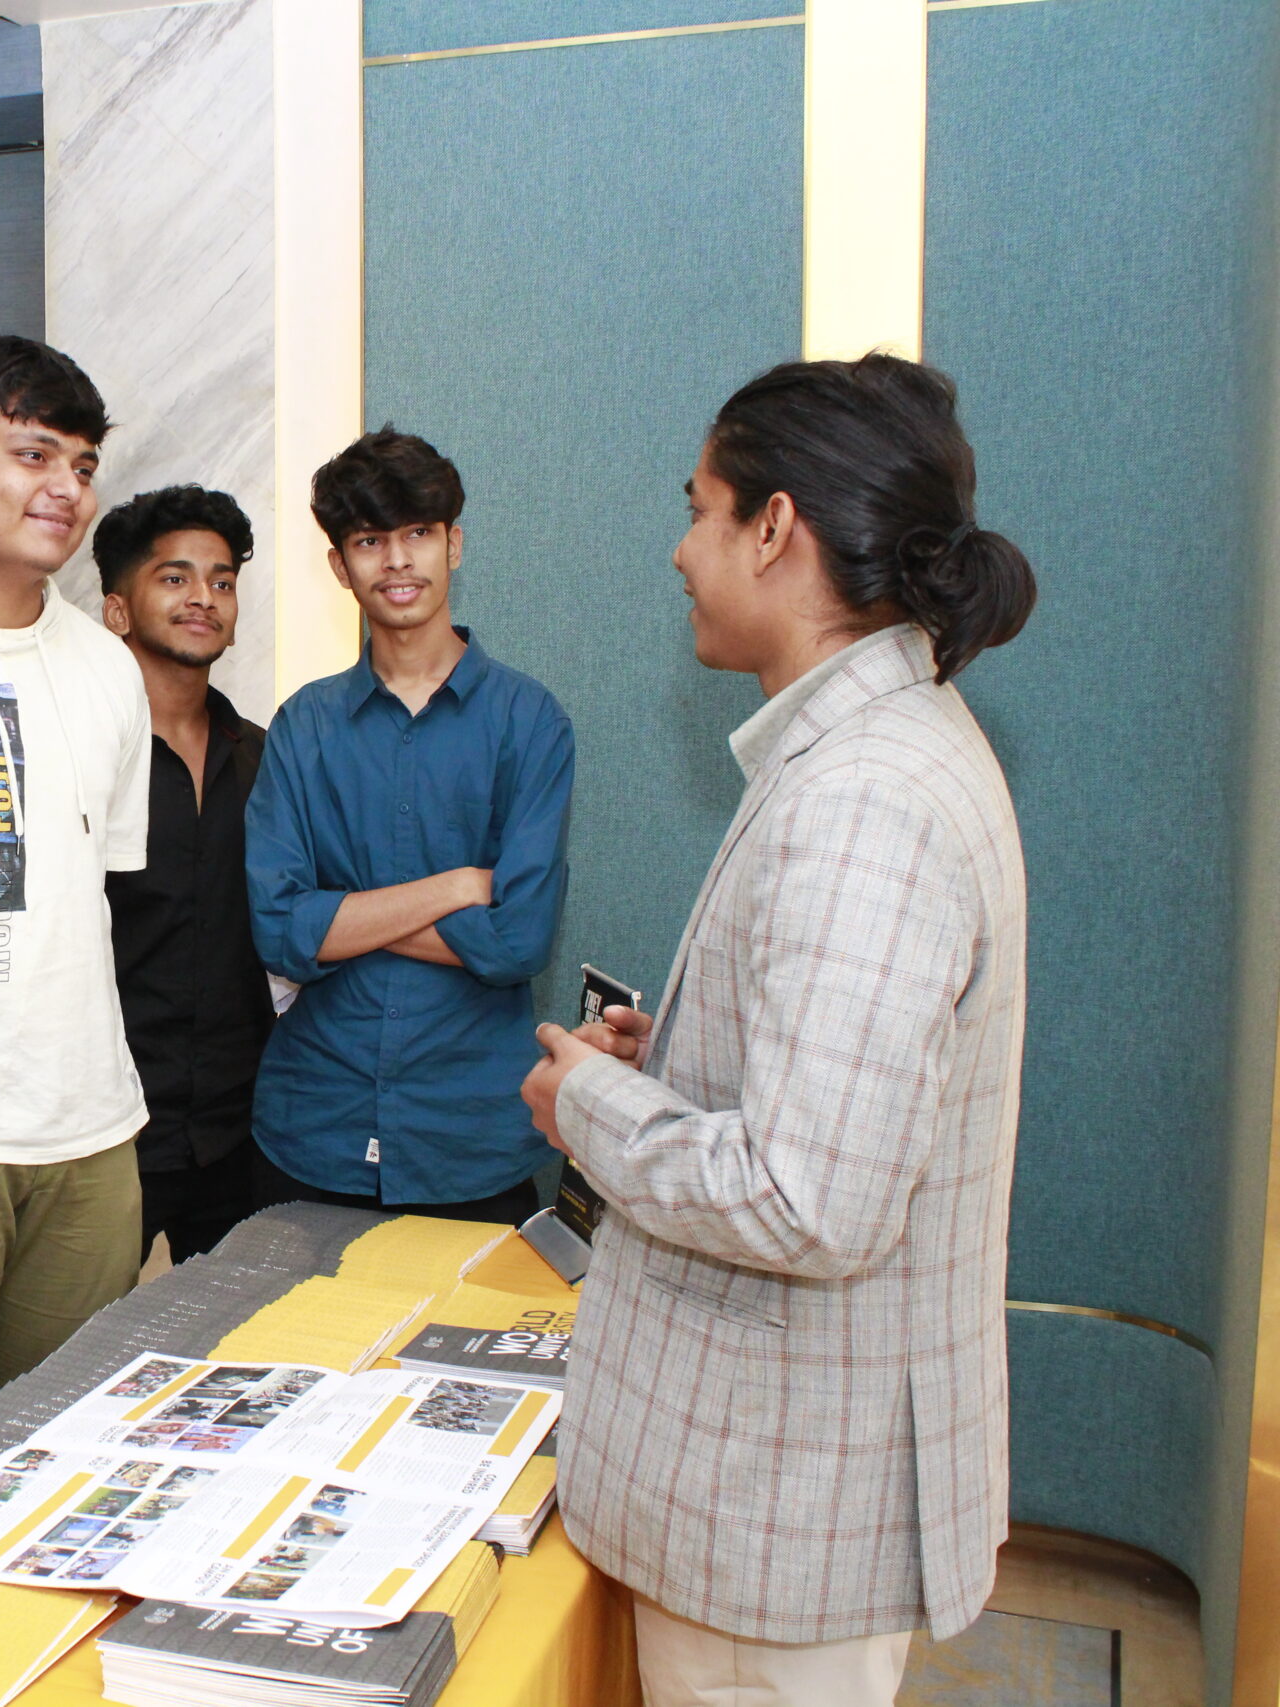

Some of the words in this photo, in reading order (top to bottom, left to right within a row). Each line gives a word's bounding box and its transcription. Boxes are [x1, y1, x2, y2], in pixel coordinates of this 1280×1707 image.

[488, 1309, 557, 1355] WORLD
[480, 1460, 492, 1468] BE
[461, 1468, 487, 1494] INSPIRED
[331, 1629, 373, 1653] OF
